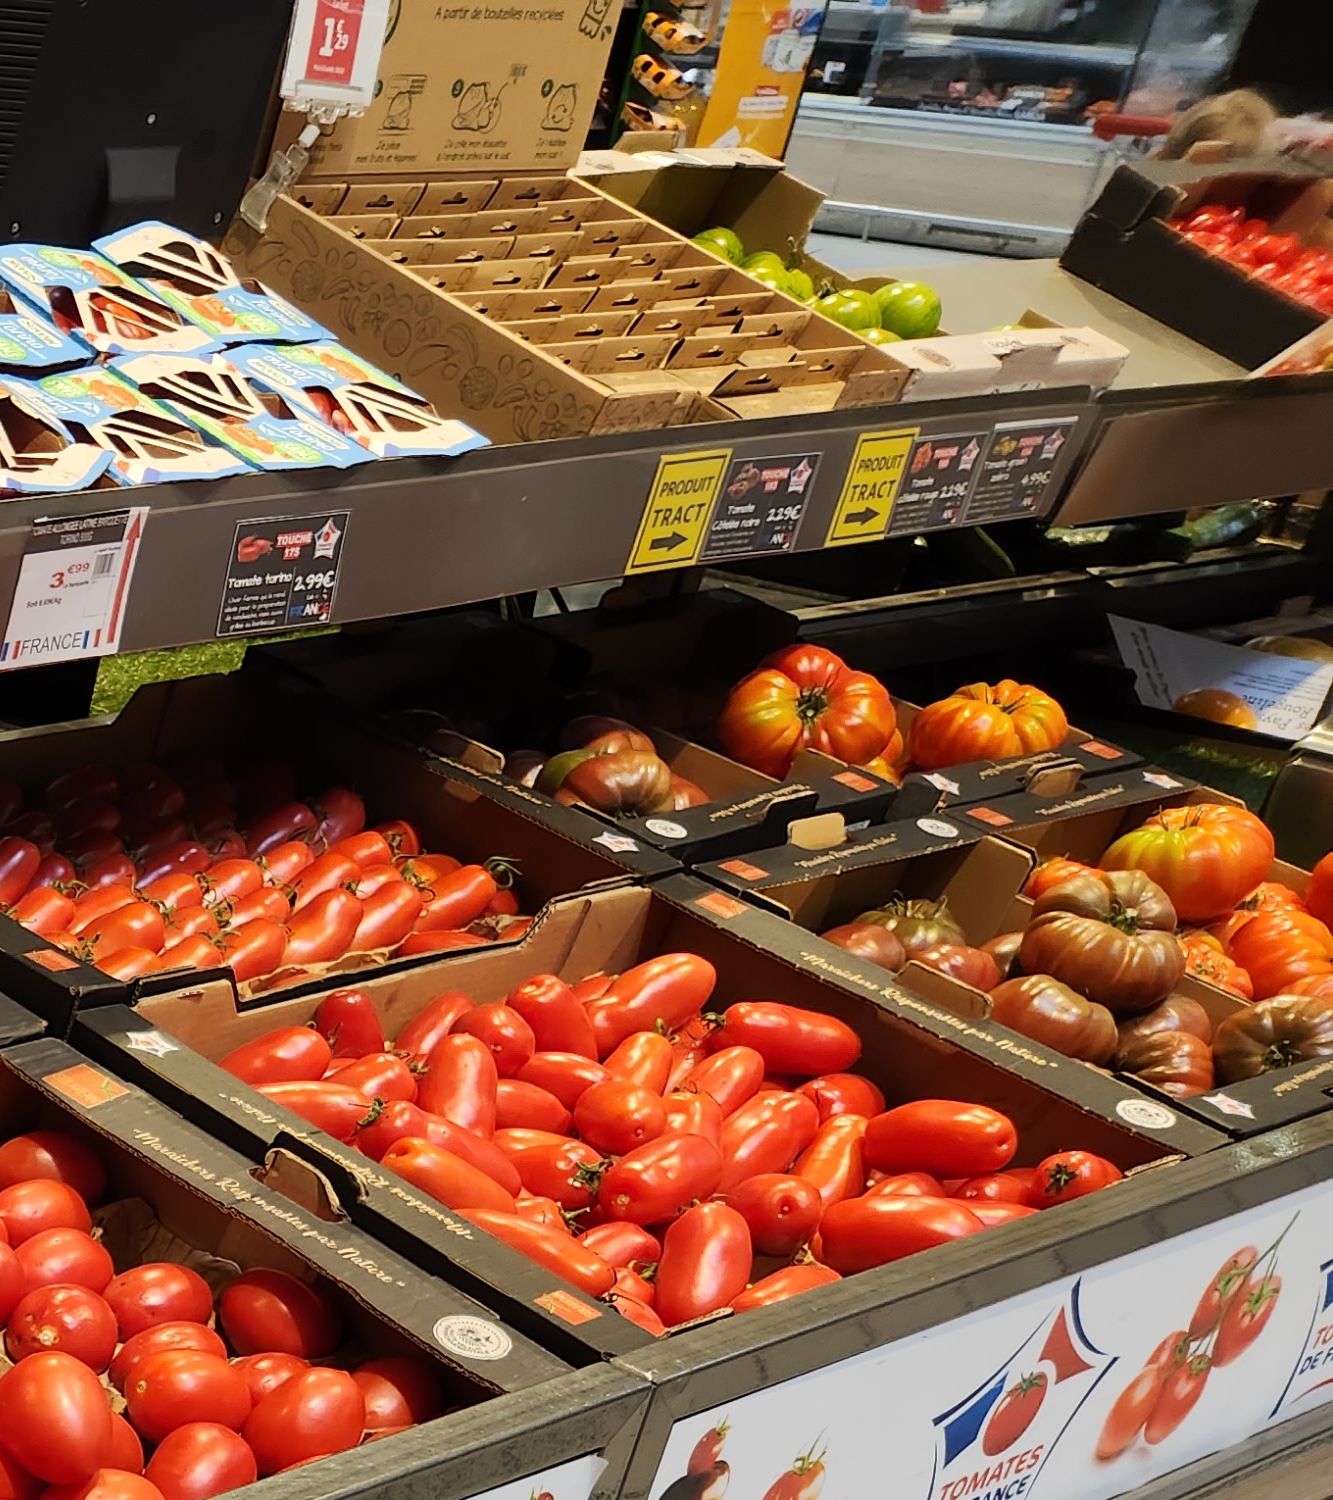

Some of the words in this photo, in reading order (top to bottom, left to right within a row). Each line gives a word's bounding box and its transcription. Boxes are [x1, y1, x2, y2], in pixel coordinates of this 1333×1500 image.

[445, 8, 470, 26] partir
[472, 8, 482, 20] de
[484, 6, 523, 20] bouteilles
[319, 17, 335, 57] 1
[334, 33, 349, 50] 29
[856, 454, 905, 473] PRODUIT
[659, 476, 715, 498] PRODUIT
[849, 479, 896, 502] TRACT
[652, 503, 706, 528] TRACT
[727, 503, 756, 516] Tomate
[740, 517, 761, 528] noire
[277, 533, 313, 545] TOUCHE
[49, 572, 65, 589] 3
[67, 563, 90, 574] €99
[228, 575, 263, 588] Tomate
[265, 572, 292, 584] torino
[294, 570, 335, 591] 2.99€
[20, 632, 82, 656] FRANCE
[302, 1226, 338, 1249] par
[1299, 1354, 1320, 1375] DE
